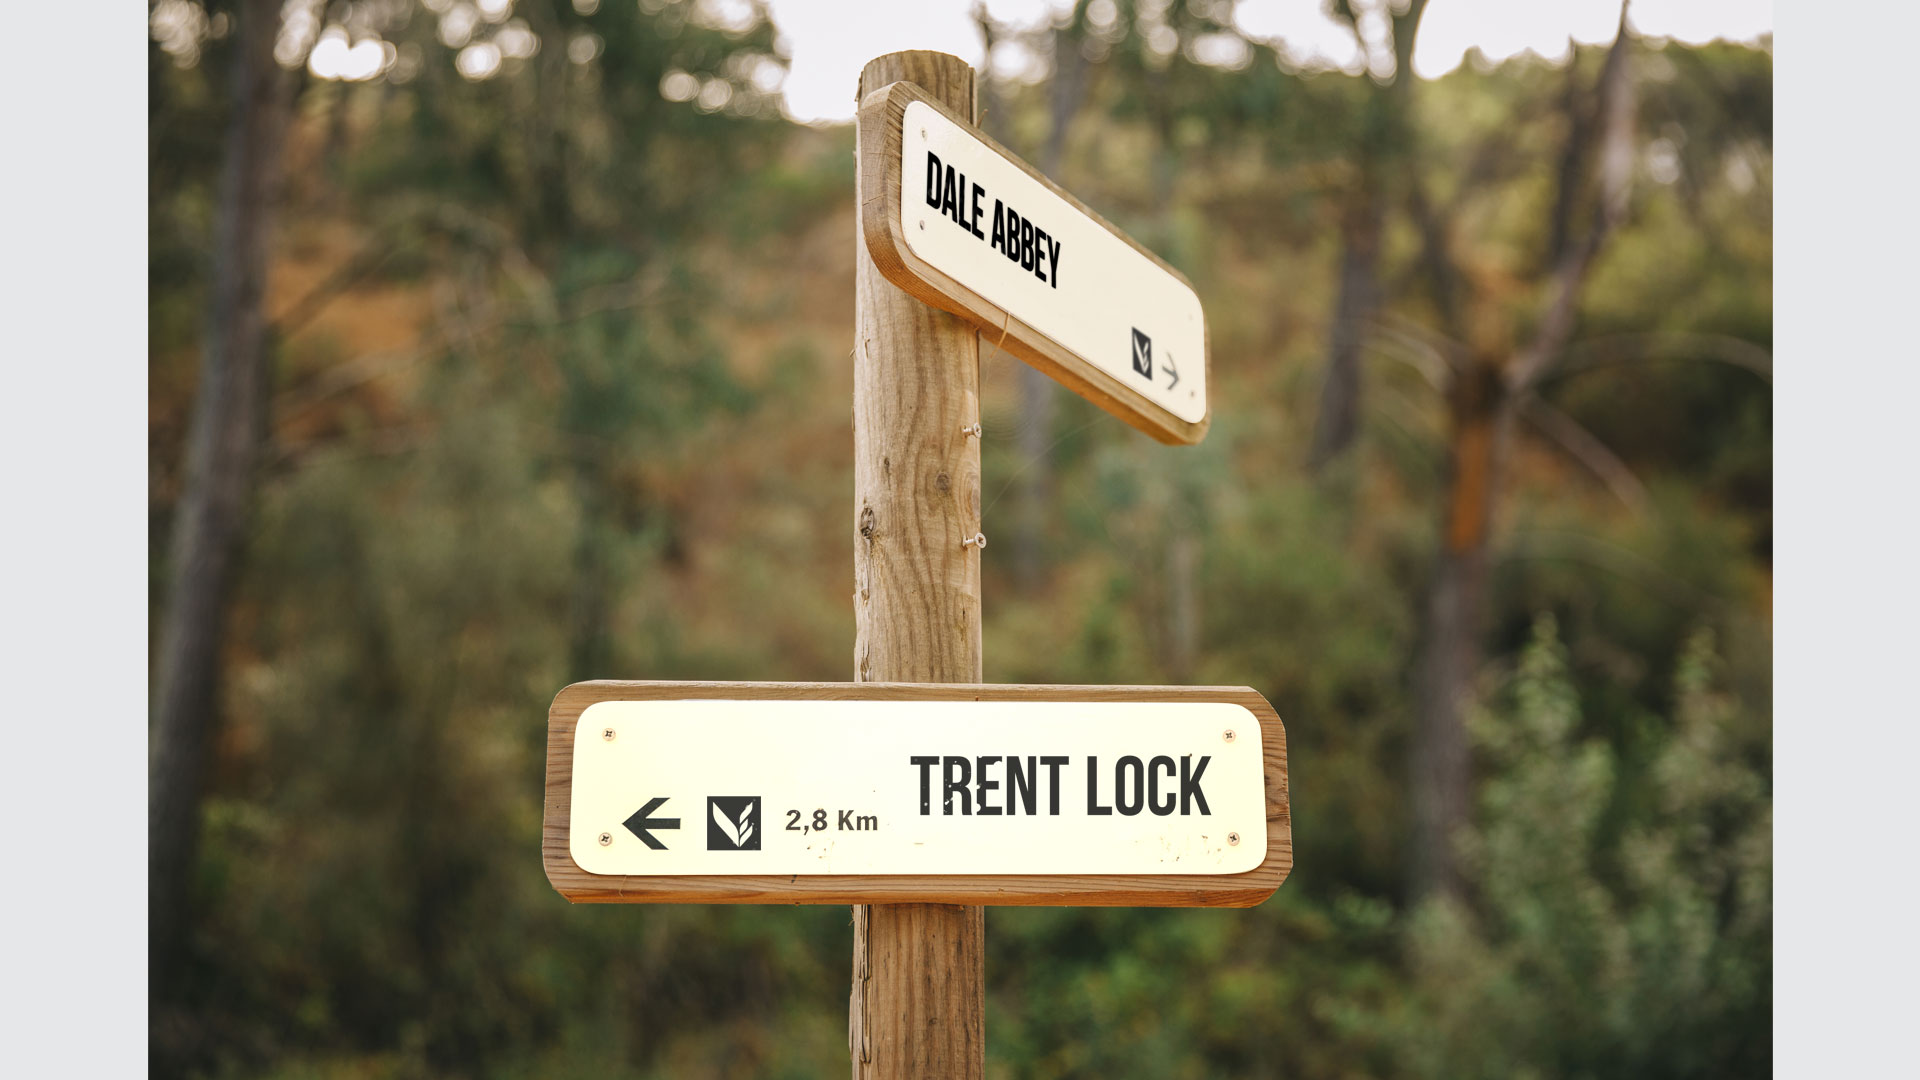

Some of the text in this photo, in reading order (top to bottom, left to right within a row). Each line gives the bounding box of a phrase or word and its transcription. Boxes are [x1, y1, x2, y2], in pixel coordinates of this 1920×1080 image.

[926, 150, 1061, 290] DALE ABBEY
[910, 755, 1212, 816] TRENT LOCK
[785, 809, 878, 836] 2,8 Km
